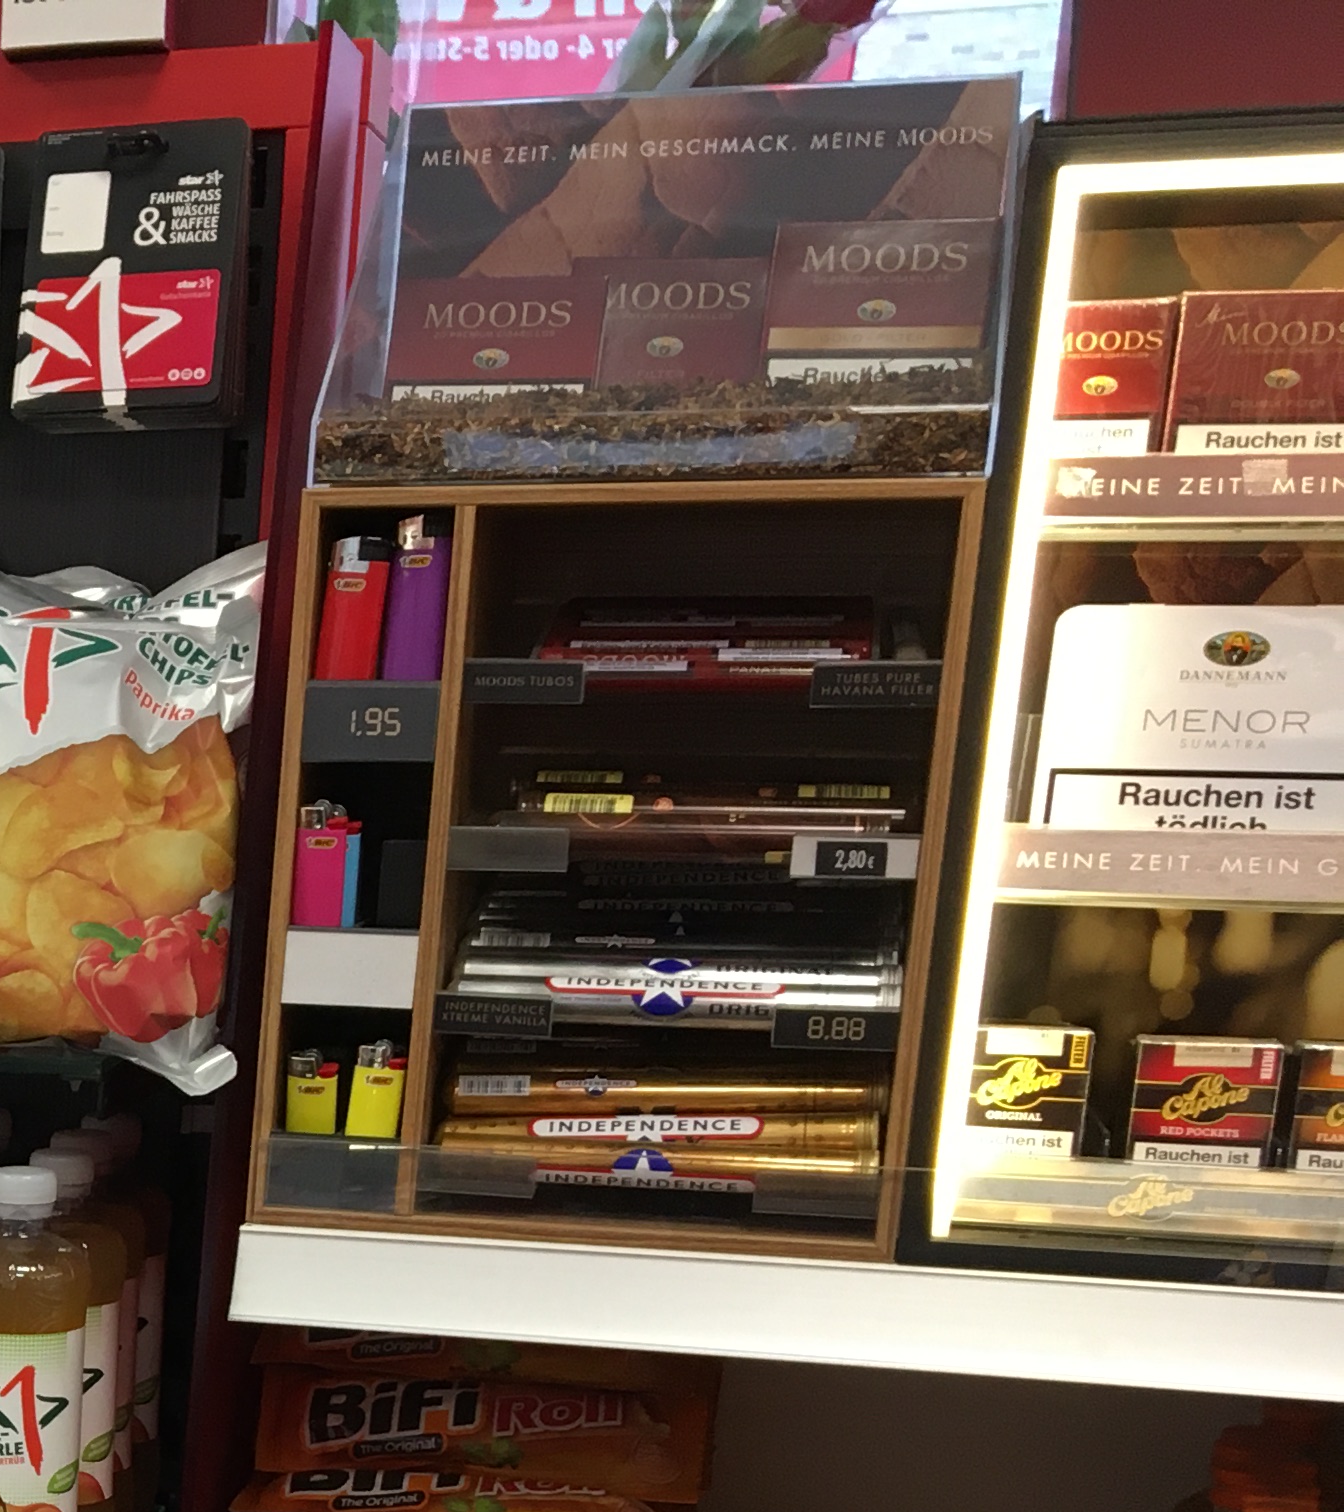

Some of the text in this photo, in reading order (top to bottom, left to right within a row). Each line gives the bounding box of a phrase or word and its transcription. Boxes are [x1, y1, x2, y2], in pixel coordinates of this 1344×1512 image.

[422, 126, 993, 167] MEINE ZEIT. MEIN GESCHMACK. MEINE MOODS
[178, 175, 204, 186] star
[150, 189, 222, 204] FAHRSPASS
[172, 203, 220, 216] WÄSCHE
[133, 207, 167, 246] &
[171, 216, 219, 230] KAFFEE
[169, 230, 218, 244] SNACKS
[801, 242, 969, 274] MOODS
[606, 281, 751, 312] MOODS
[423, 301, 573, 331] MOODS
[1205, 430, 1343, 449] Rauchen ist
[474, 675, 574, 688] MOODS TUBOS
[835, 672, 920, 684] TUBES PURE
[1179, 669, 1288, 682] DANNEMANN
[821, 683, 934, 696] HAVANA FILLER
[1142, 709, 1311, 735] MENOR
[1179, 738, 1267, 750] SUMATRA
[1118, 784, 1315, 811] Rauchen ist
[1017, 851, 1302, 878] MEINE ZEIT. MEIN
[567, 977, 763, 991] INDEPENDENCE
[444, 1002, 545, 1016] INDEPENDENCE
[441, 1013, 546, 1028] XTREME VANILLA
[1162, 1087, 1250, 1121] Capone
[985, 1109, 1043, 1122] ORIGINAL
[548, 1119, 741, 1132] INDEPENDENCE
[1160, 1126, 1239, 1138] RED POCKETS
[1145, 1147, 1250, 1164] Rauchen ist
